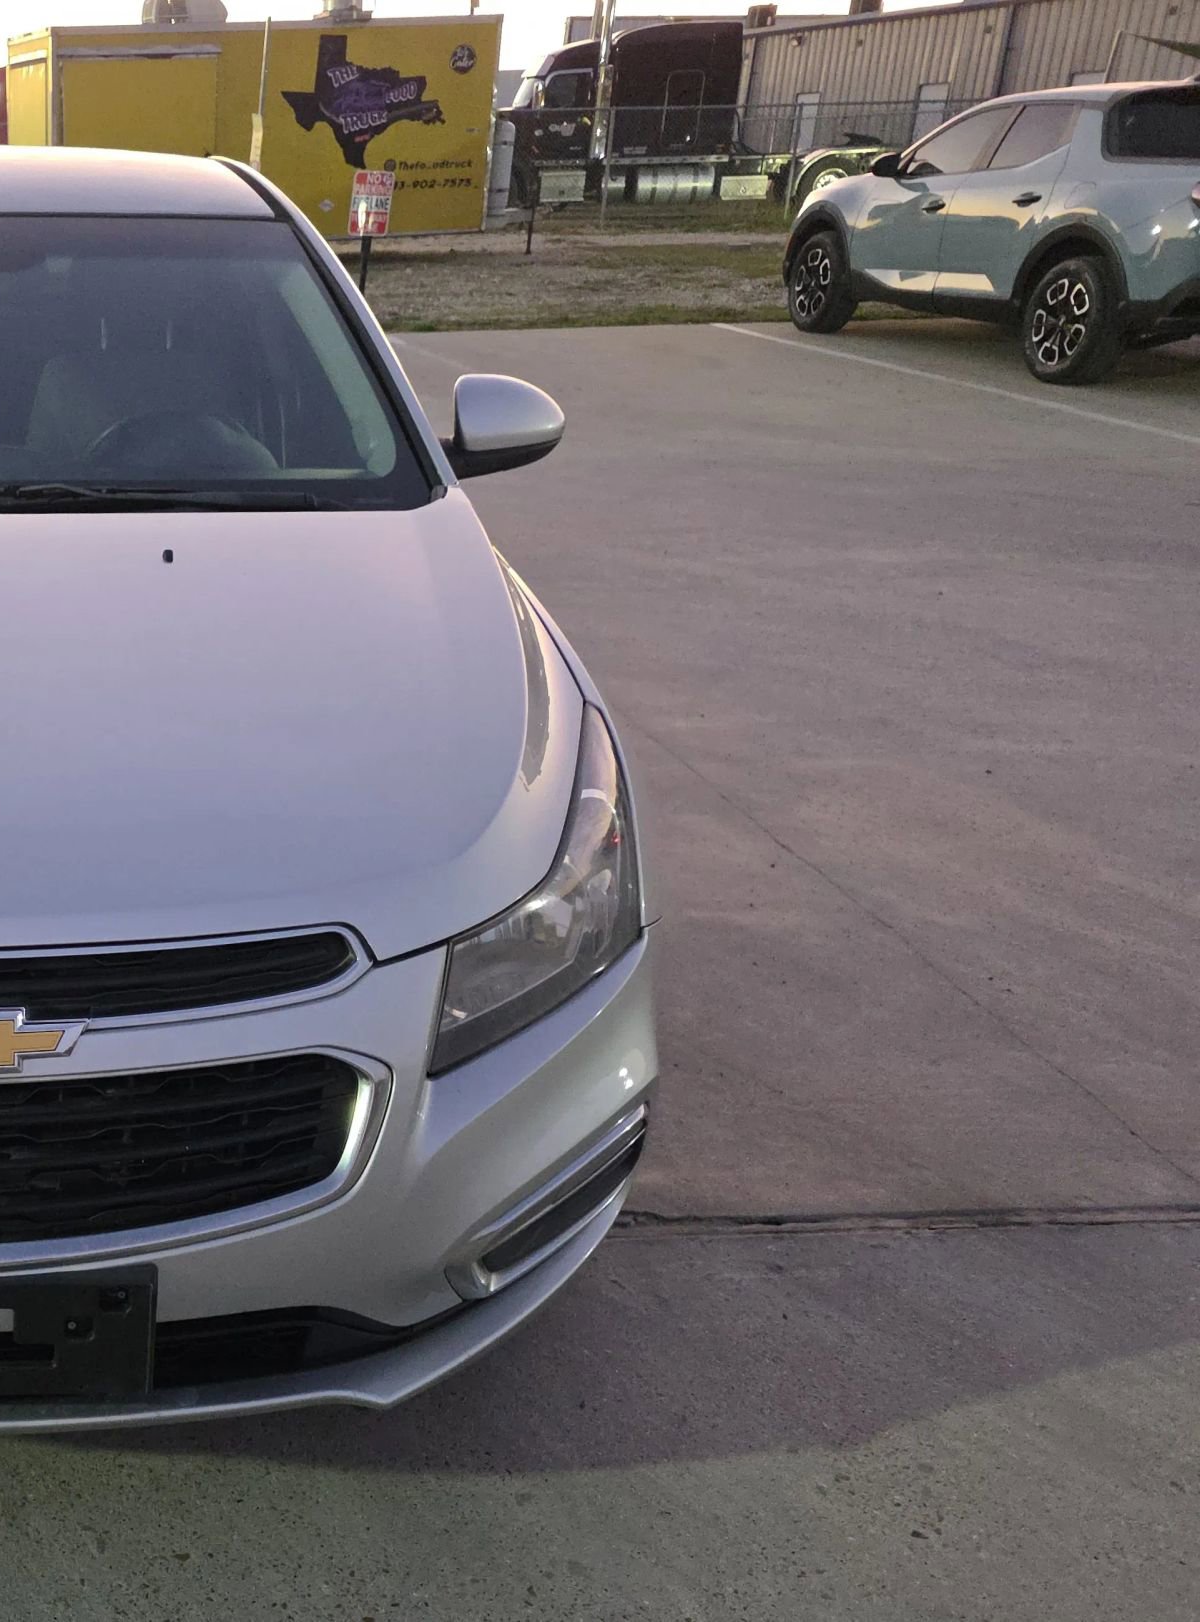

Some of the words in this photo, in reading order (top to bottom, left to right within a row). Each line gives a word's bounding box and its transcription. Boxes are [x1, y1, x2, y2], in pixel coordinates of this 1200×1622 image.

[327, 65, 360, 88] THE
[340, 111, 388, 134] TRUCK
[367, 173, 381, 184] NO
[369, 197, 389, 211] LANE
